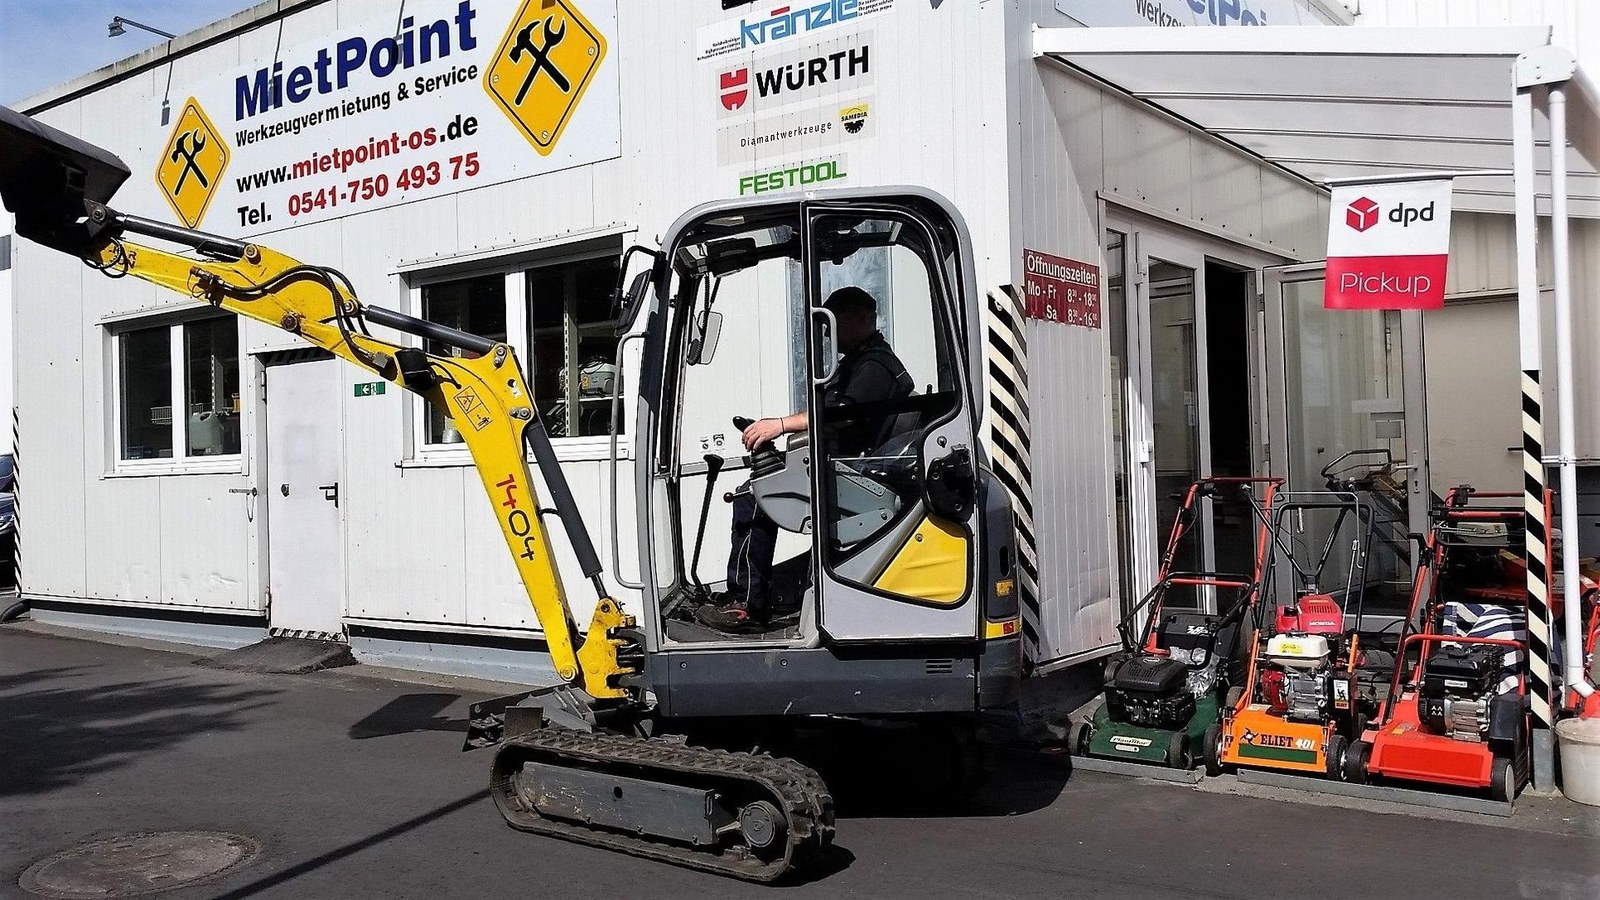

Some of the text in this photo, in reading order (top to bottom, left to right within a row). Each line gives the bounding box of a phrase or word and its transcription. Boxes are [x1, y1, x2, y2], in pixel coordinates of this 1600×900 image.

[236, 0, 477, 122] MietPoint
[236, 65, 478, 147] Werkzeugvermietung & Service
[740, 121, 832, 147] Diamantwerkzeuge
[236, 114, 478, 193] www.mietpoint-os.de
[237, 152, 480, 227] Tel. 0541-750 493 75
[739, 161, 847, 195] FESTOOL
[1388, 201, 1435, 227] dpd
[1027, 251, 1097, 286] Öffnungszeiten
[1340, 272, 1431, 297] Pickup
[1027, 280, 1041, 297] Mo
[1047, 284, 1057, 300] Fr
[1046, 305, 1057, 320] Sa
[496, 473, 535, 561] 1404
[1260, 734, 1294, 748] ELIET
